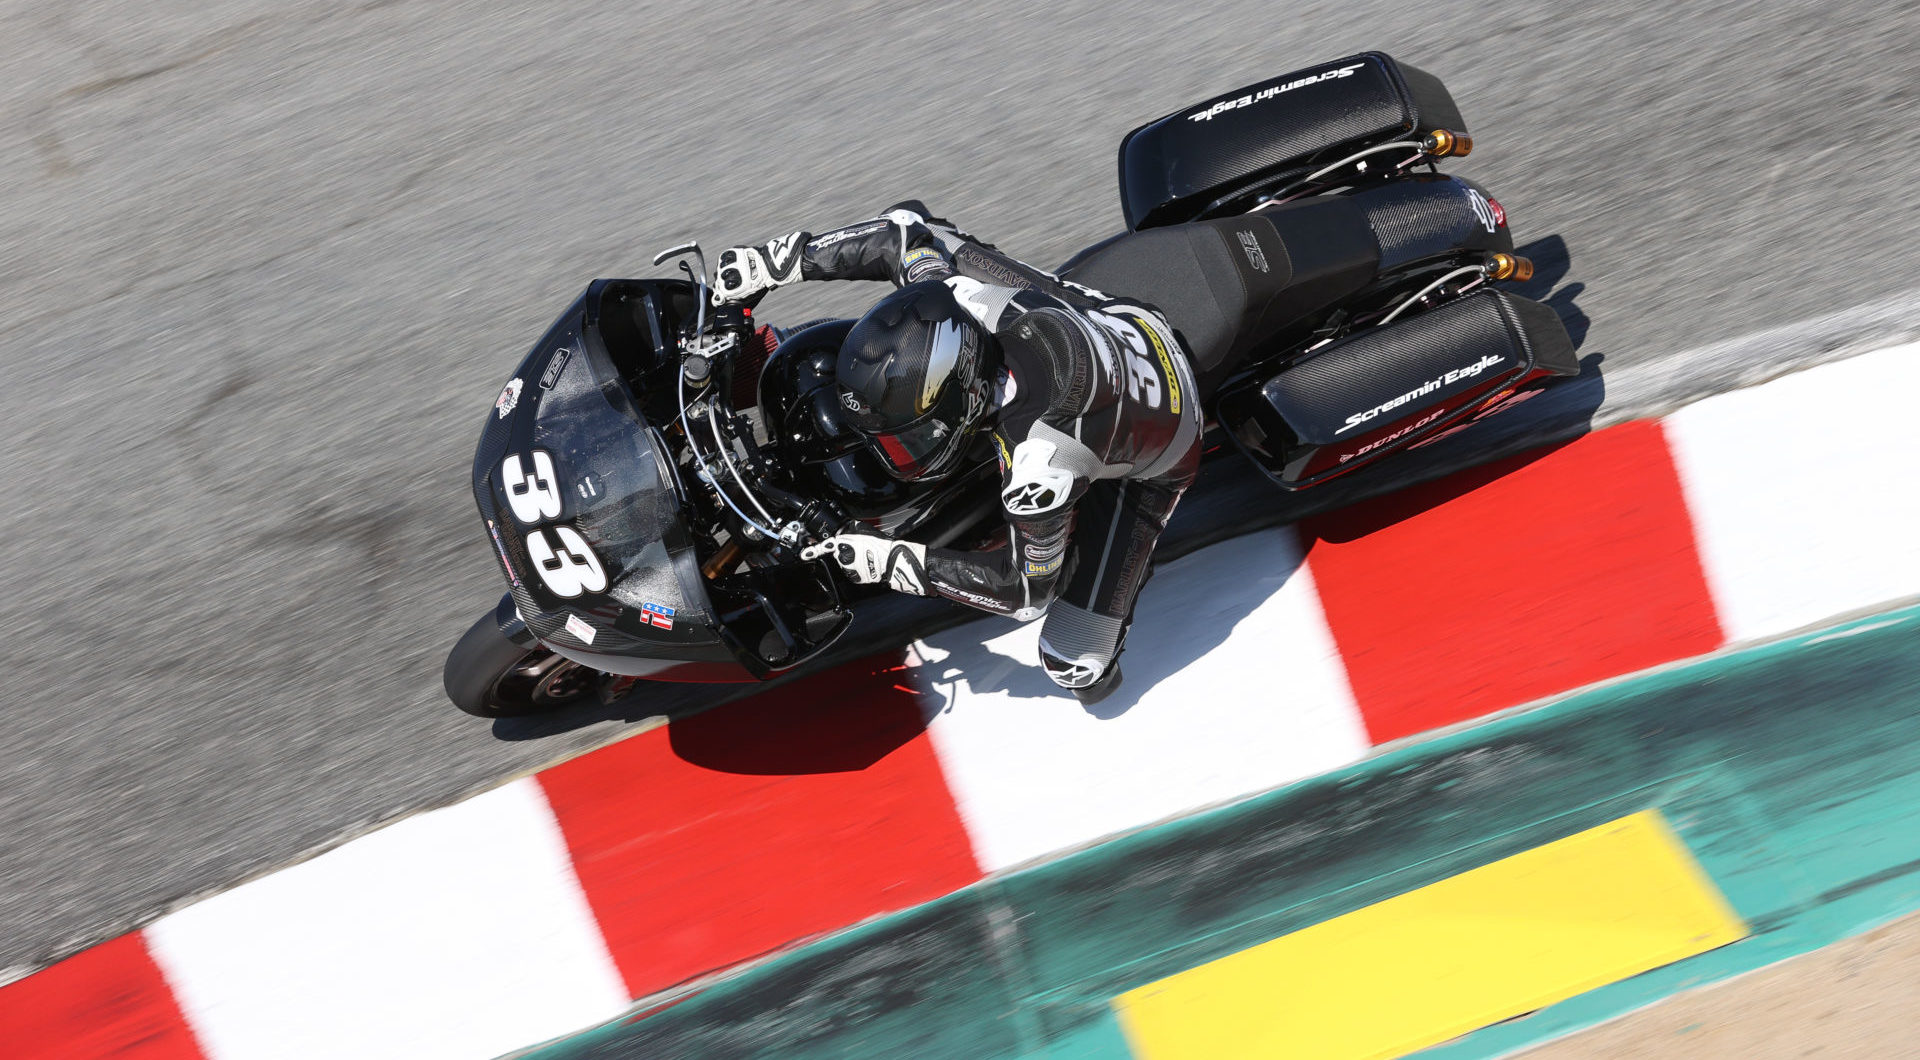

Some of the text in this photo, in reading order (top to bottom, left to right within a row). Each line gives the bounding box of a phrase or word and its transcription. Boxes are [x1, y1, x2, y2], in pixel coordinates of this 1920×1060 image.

[1187, 94, 1254, 123] Eagle
[1334, 375, 1444, 436] Screamin'
[1444, 354, 1506, 386] Eagle
[1355, 408, 1446, 457] DUNLOP
[502, 450, 609, 600] 33
